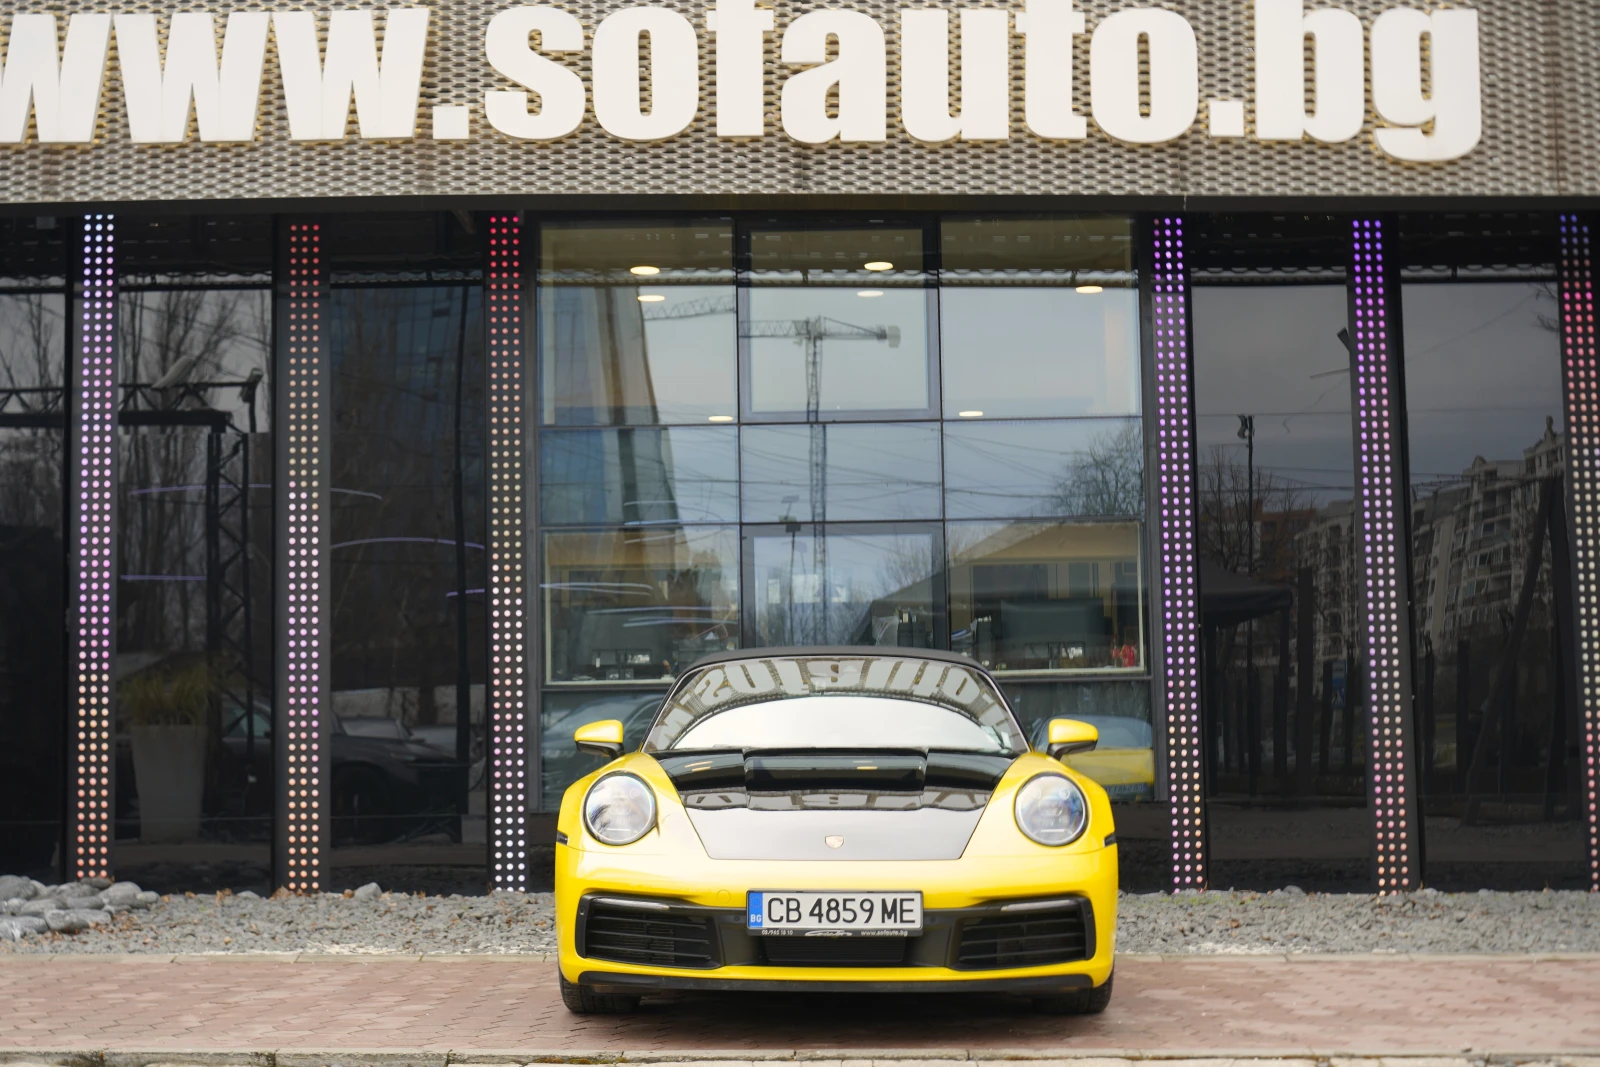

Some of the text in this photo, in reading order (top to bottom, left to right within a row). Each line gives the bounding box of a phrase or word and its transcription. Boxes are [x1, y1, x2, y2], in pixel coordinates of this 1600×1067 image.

[0, 0, 1481, 162] www.sofauto.bg
[749, 914, 762, 923] BG
[767, 897, 916, 924] CB 4859 ME
